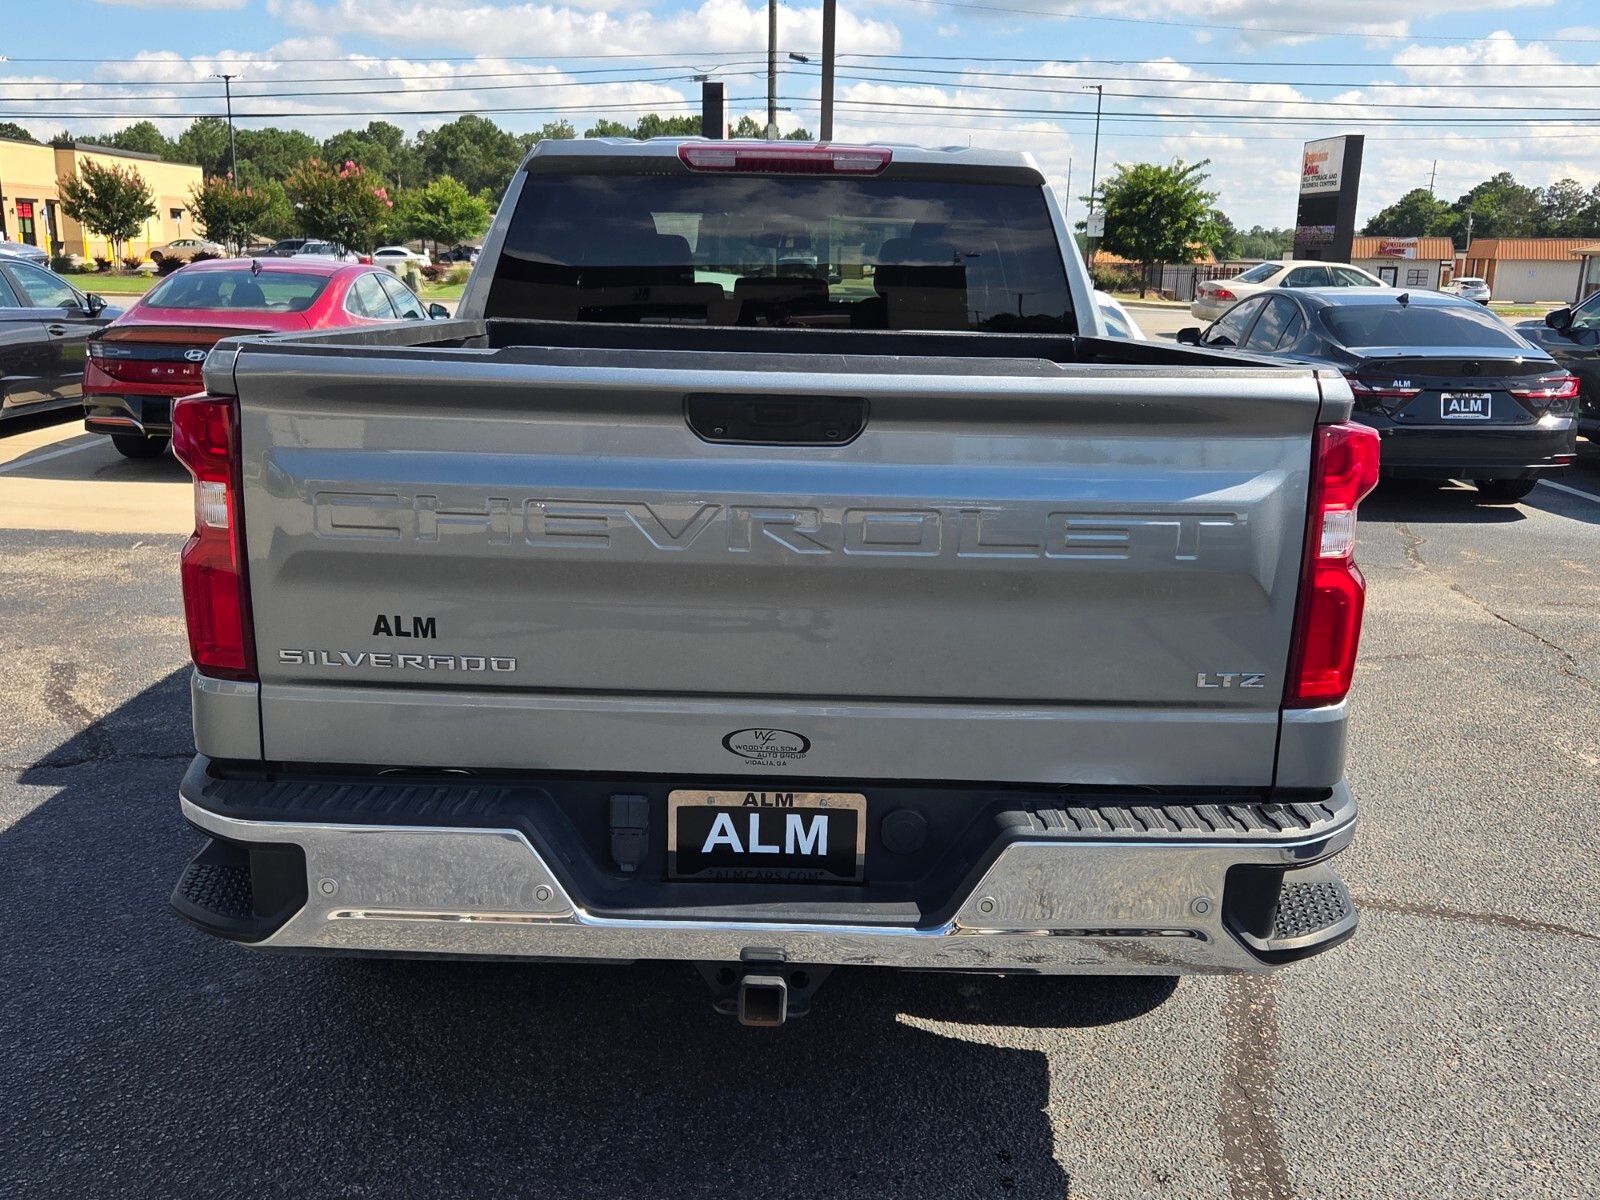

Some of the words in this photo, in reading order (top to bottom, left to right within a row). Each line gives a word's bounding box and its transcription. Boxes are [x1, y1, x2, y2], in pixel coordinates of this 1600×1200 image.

[1392, 380, 1411, 388] ALM
[1449, 399, 1482, 412] ALM
[312, 490, 1247, 562] CHEVROLET
[372, 614, 437, 639] ALM
[279, 649, 518, 673] SILVERADO
[1196, 672, 1266, 688] LTZ
[742, 792, 794, 808] ALM
[701, 812, 829, 856] ALM
